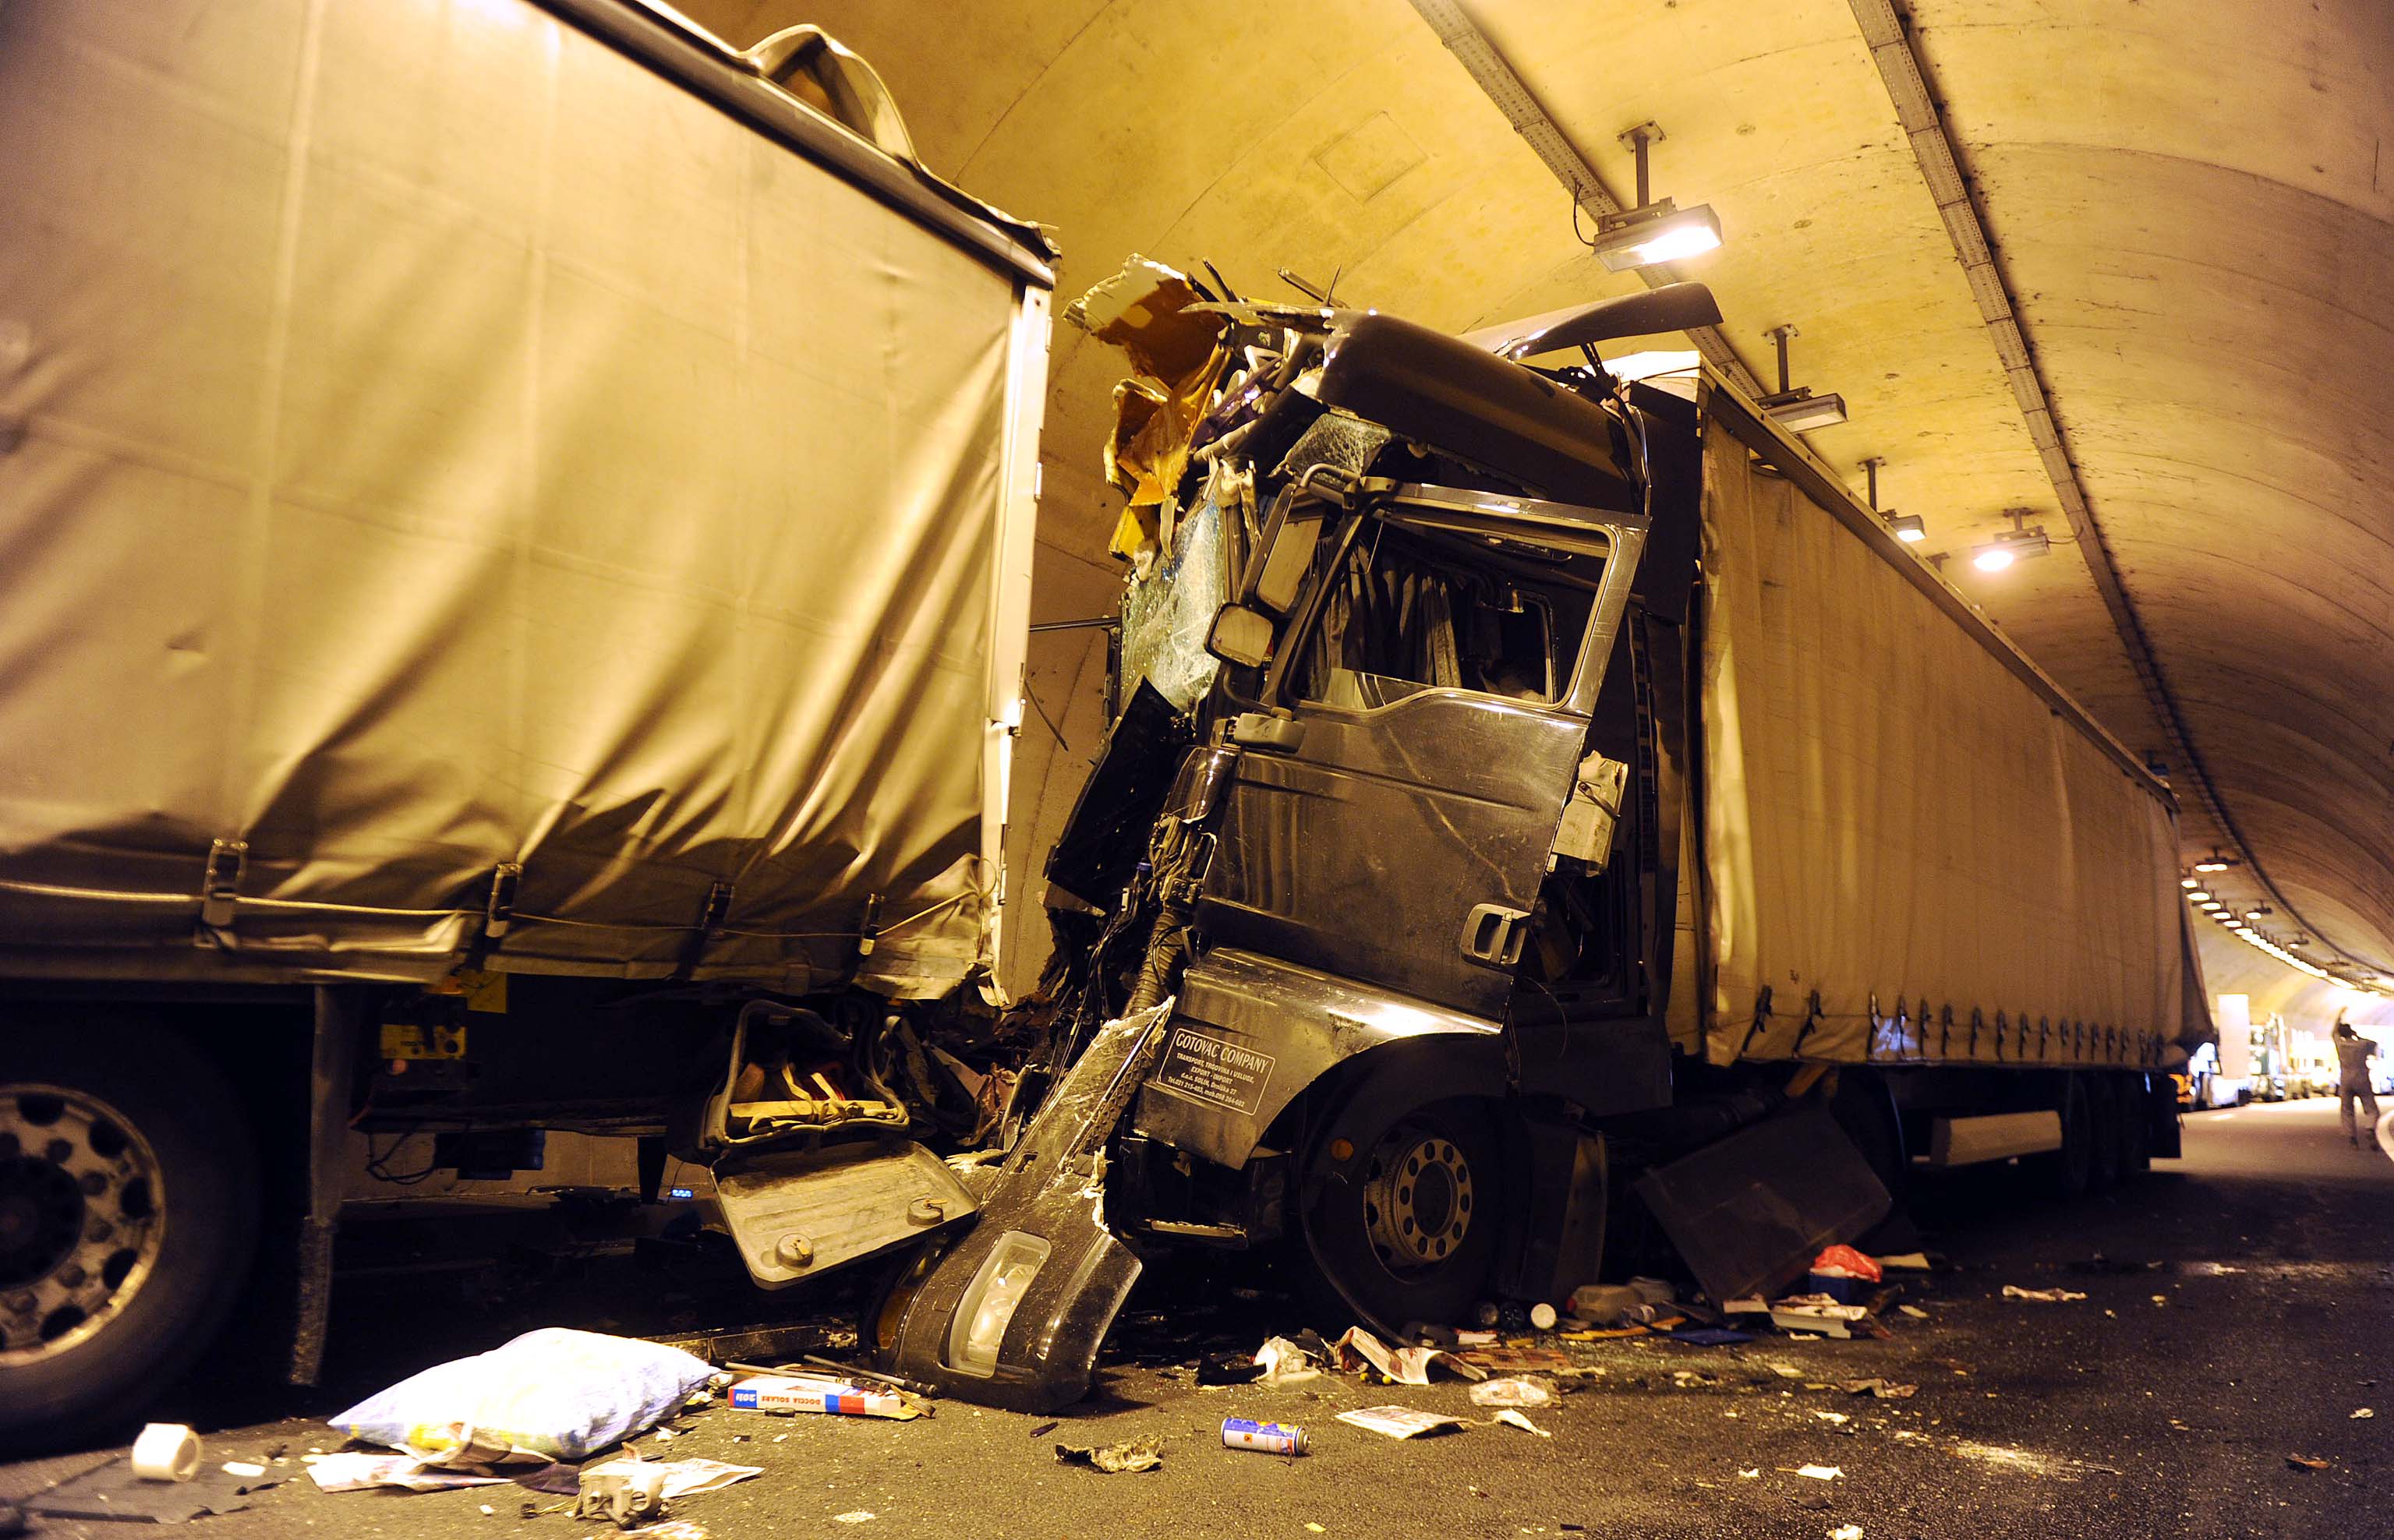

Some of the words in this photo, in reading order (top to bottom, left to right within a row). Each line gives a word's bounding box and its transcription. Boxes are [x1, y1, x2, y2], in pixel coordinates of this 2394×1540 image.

[1176, 1033, 1220, 1058] GOTOVAC
[1220, 1047, 1269, 1074] COMPANY
[1177, 1053, 1204, 1068] TRANSPORT,
[1205, 1061, 1229, 1076] TRGOVINA
[1233, 1069, 1254, 1084] USLUGE,
[1191, 1067, 1211, 1078] EXPORT
[1213, 1073, 1232, 1084] IMPORT
[761, 1395, 791, 1404] SOLARE
[793, 1397, 821, 1405] DOCCIA
